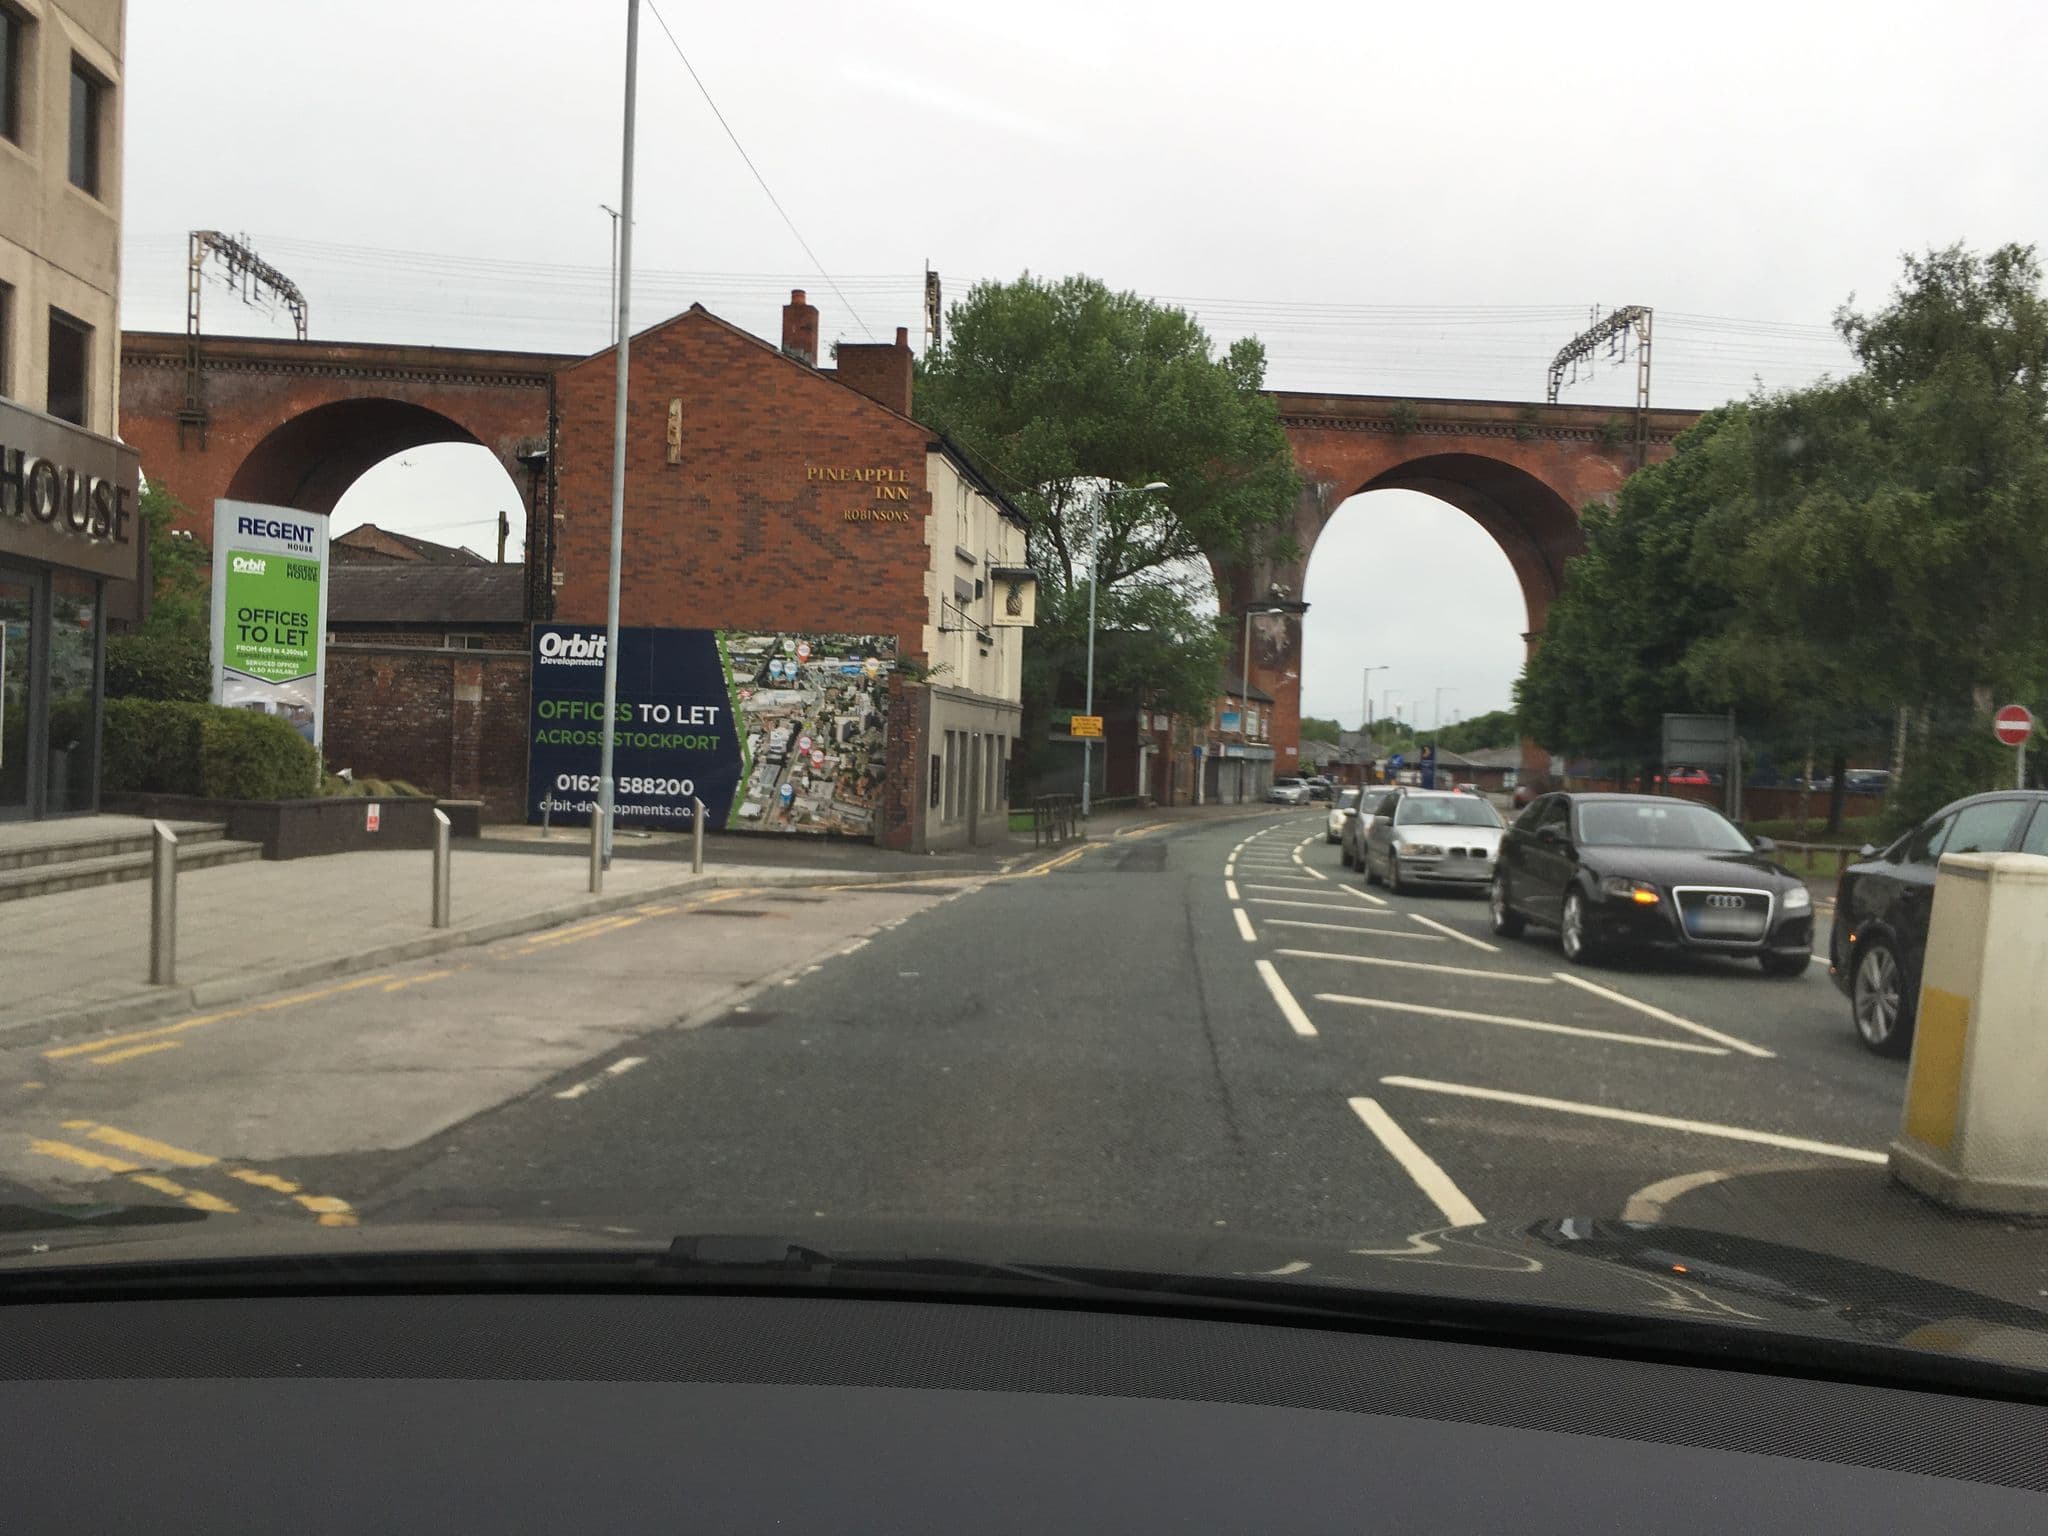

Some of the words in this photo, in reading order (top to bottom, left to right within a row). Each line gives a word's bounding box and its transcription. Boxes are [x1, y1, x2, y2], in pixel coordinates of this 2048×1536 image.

[807, 467, 910, 482] PINEAPPLE
[0, 444, 131, 545] HOUSE
[875, 486, 910, 500] INN
[844, 509, 910, 522] ROBINSONS
[238, 516, 315, 543] REGENT
[287, 543, 313, 553] HOUSE
[233, 557, 266, 572] Orbit
[286, 570, 318, 582] HOUSE
[238, 607, 309, 628] OFFICES
[237, 624, 268, 643] TO
[274, 628, 309, 647] LET
[539, 632, 607, 658] Orbit
[540, 656, 604, 667] Developments
[639, 703, 671, 723] TO
[677, 705, 720, 725] LET
[613, 732, 720, 750] STOCKPORT
[557, 774, 601, 793] 0162
[619, 777, 695, 796] 588200
